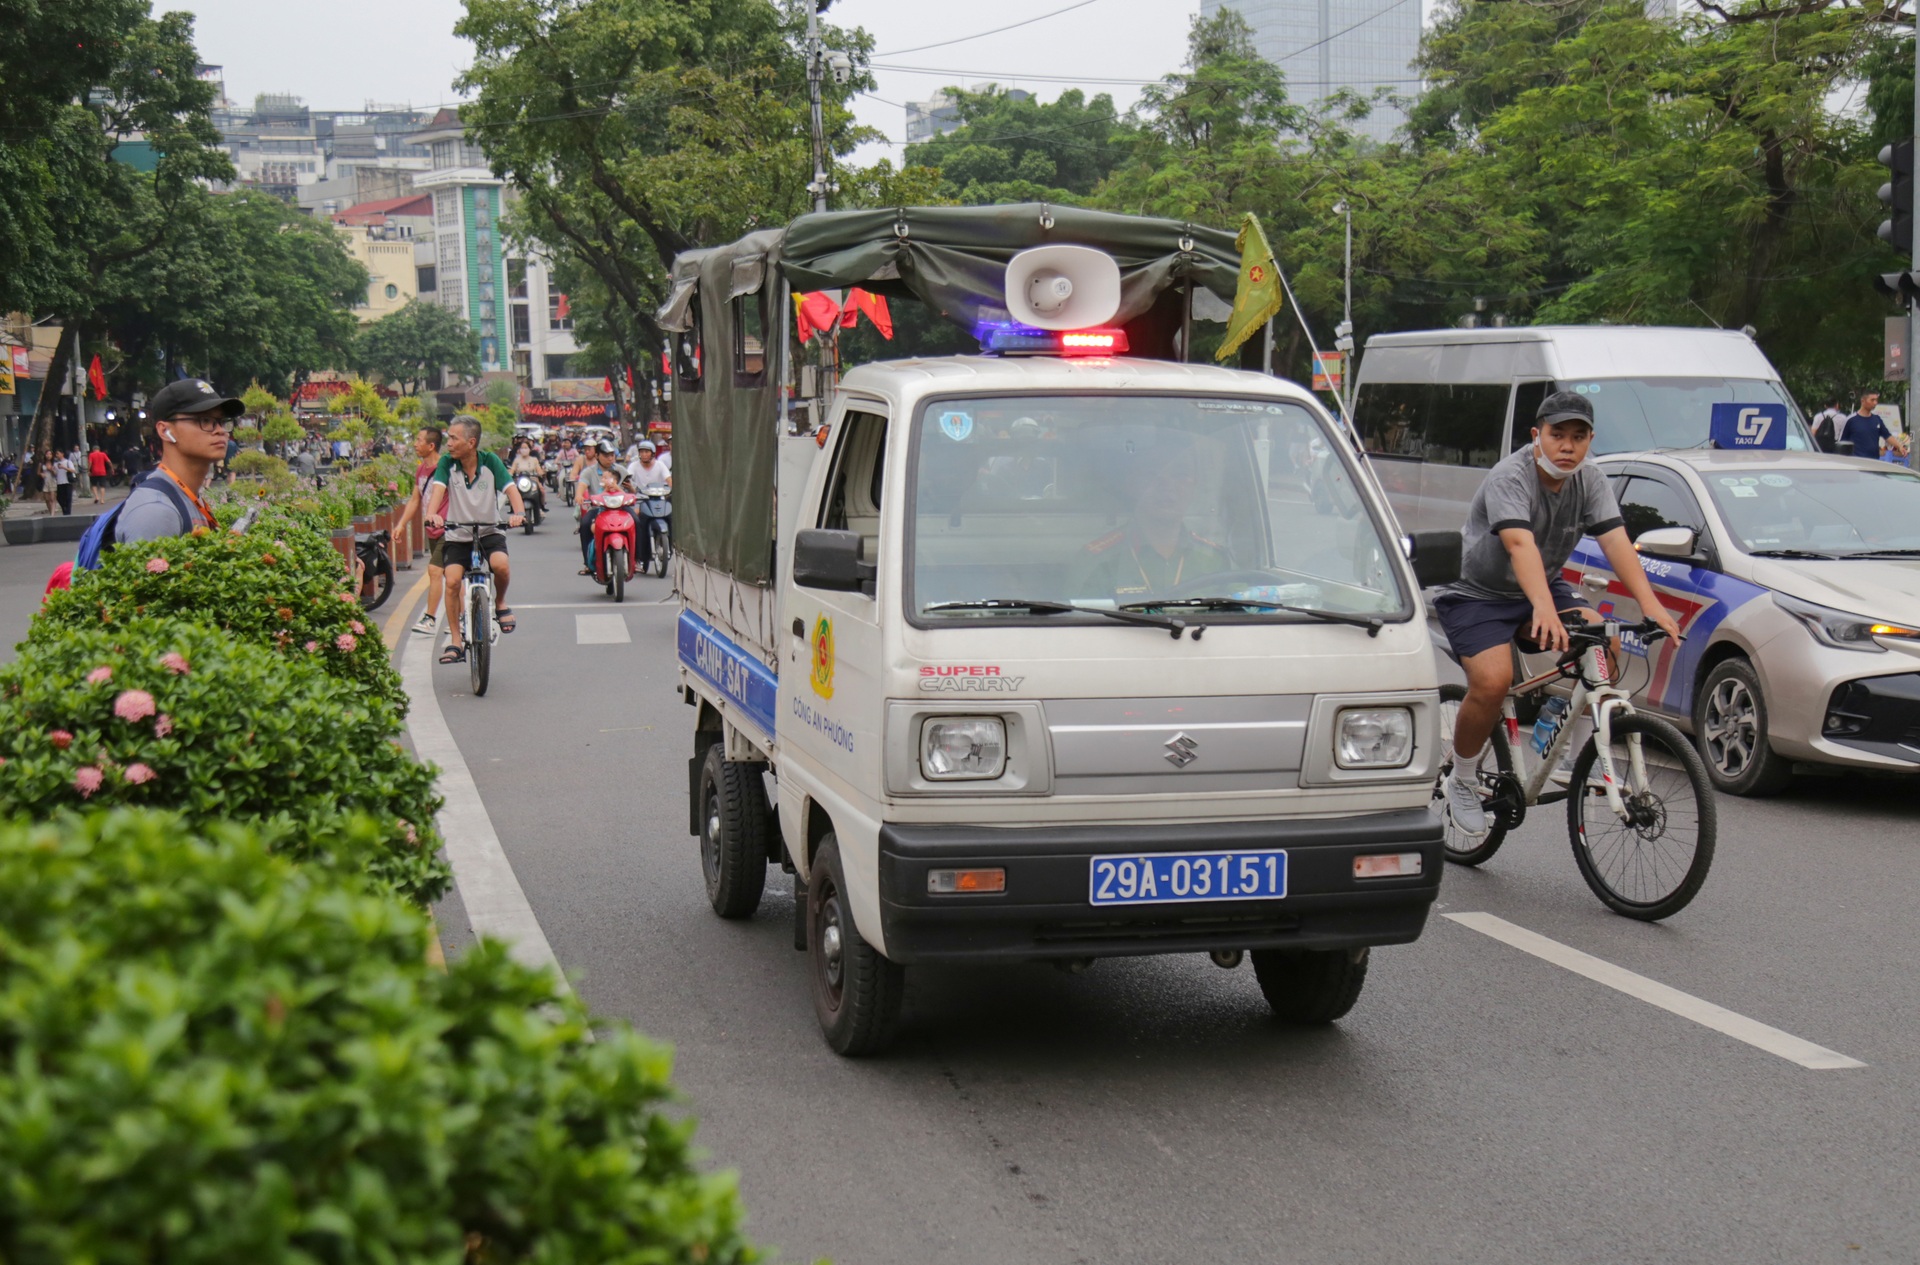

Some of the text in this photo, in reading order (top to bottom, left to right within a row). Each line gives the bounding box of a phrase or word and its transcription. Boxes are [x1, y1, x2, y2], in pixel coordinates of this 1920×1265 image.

[1737, 408, 1772, 445] G7
[1734, 437, 1753, 445] TAXI
[919, 666, 1001, 676] SUPER
[918, 677, 1024, 692] CARRY
[793, 695, 811, 725] CÔNG
[812, 710, 822, 733] AN
[1096, 856, 1277, 899] 29A-031.51
